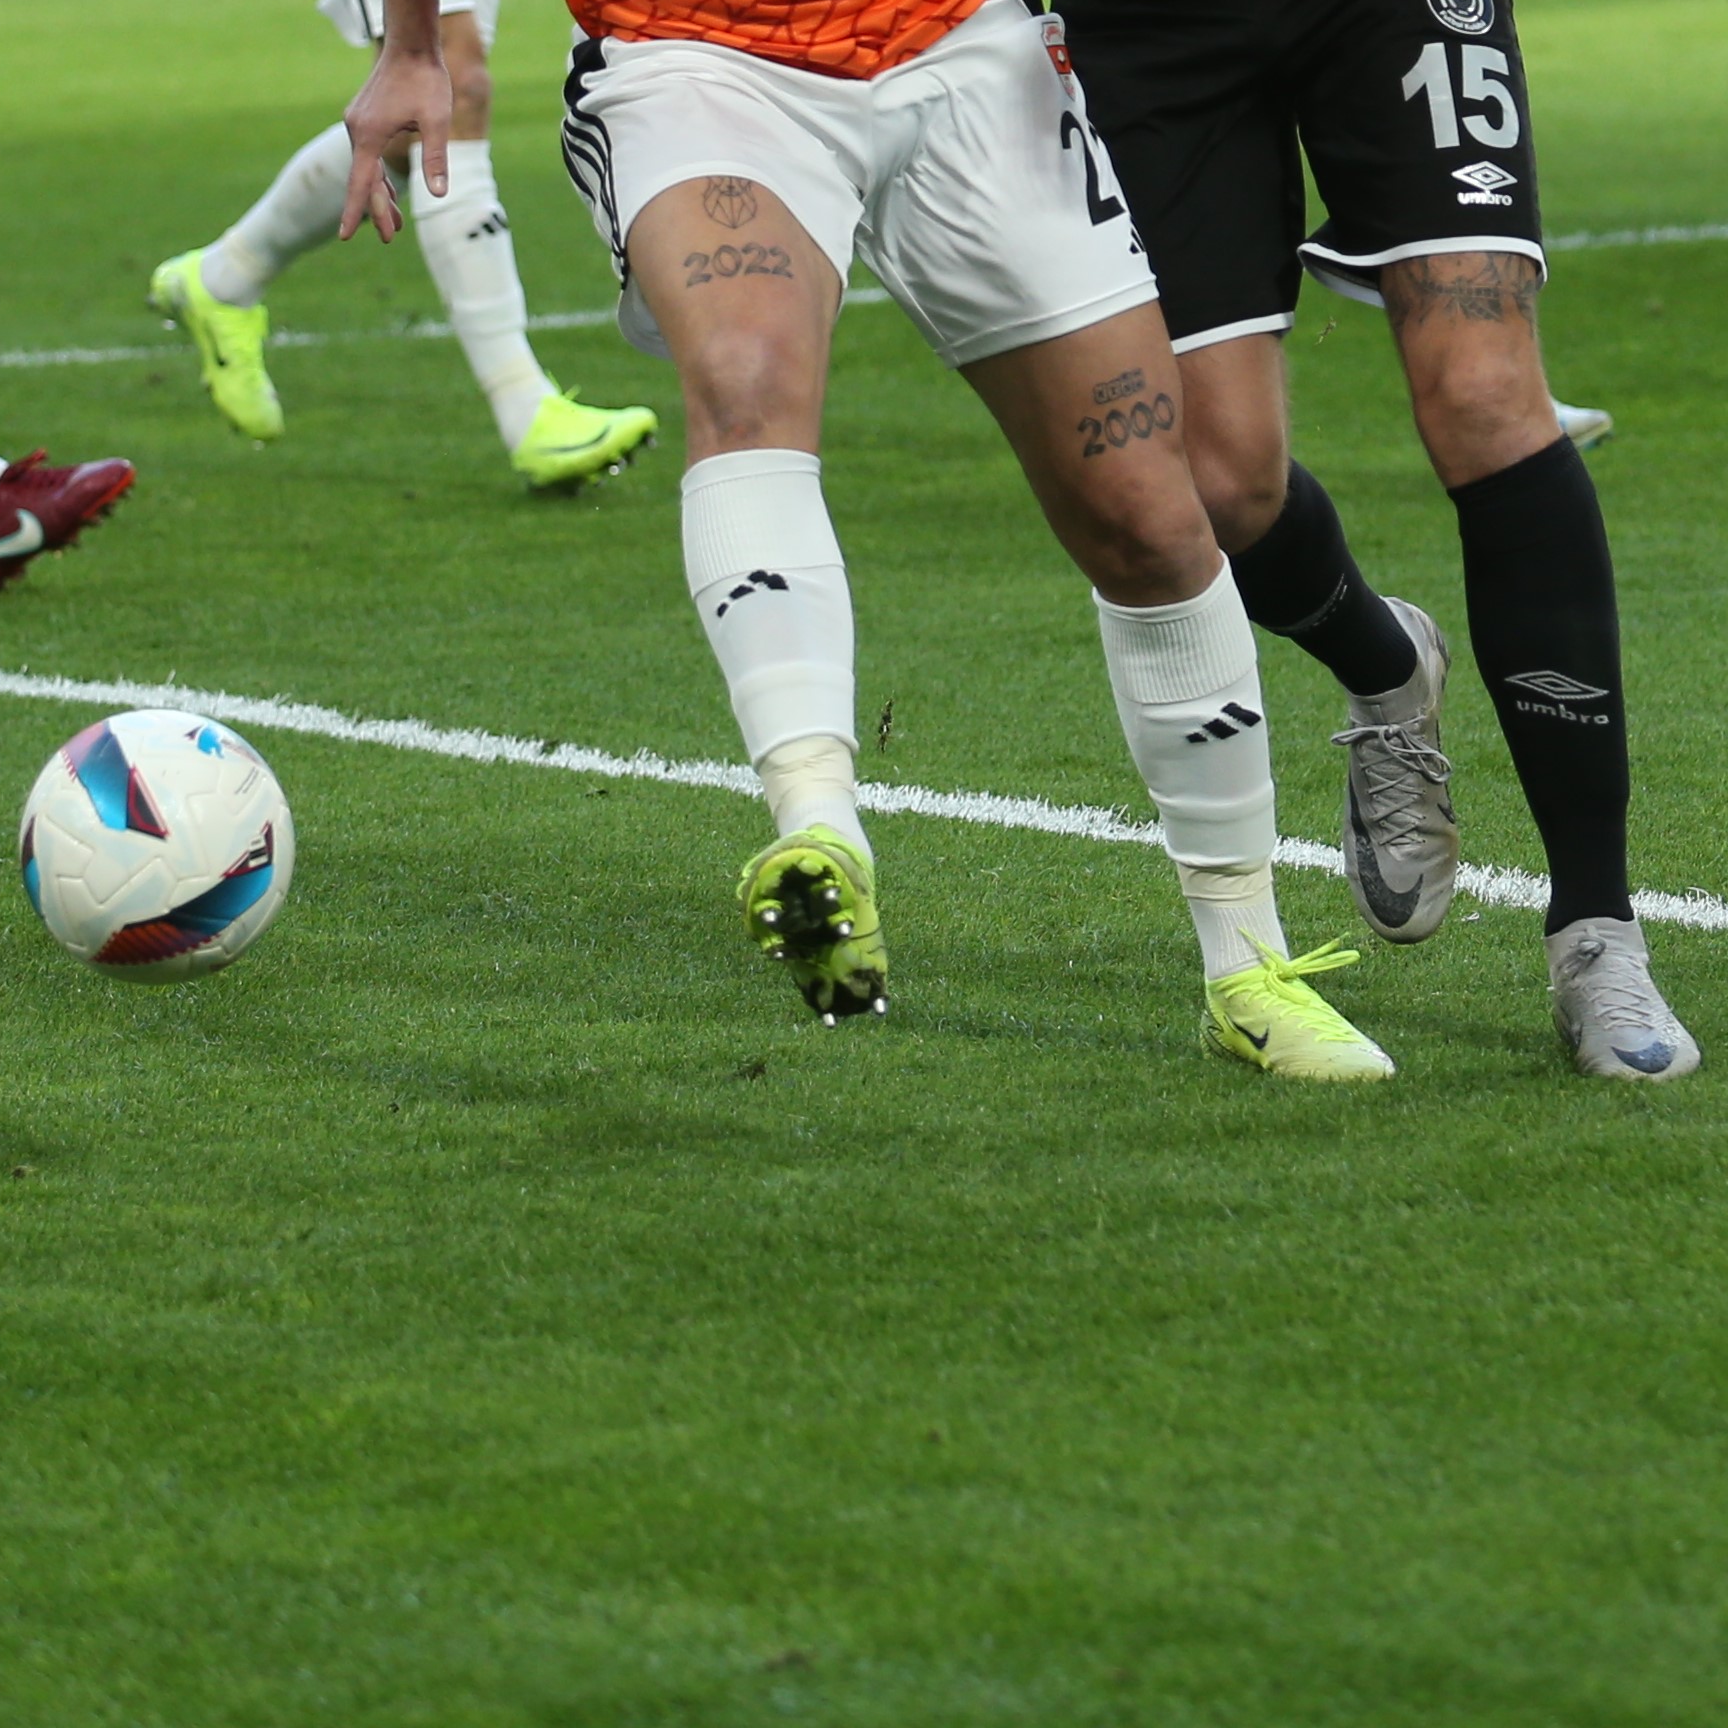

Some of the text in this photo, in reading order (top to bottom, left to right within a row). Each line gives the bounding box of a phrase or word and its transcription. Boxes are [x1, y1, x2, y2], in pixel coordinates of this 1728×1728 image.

[1400, 41, 1521, 150] 15
[1456, 187, 1513, 207] umbro
[683, 241, 795, 289] 2022
[1076, 392, 1176, 459] 2000
[1515, 699, 1610, 725] umbro
